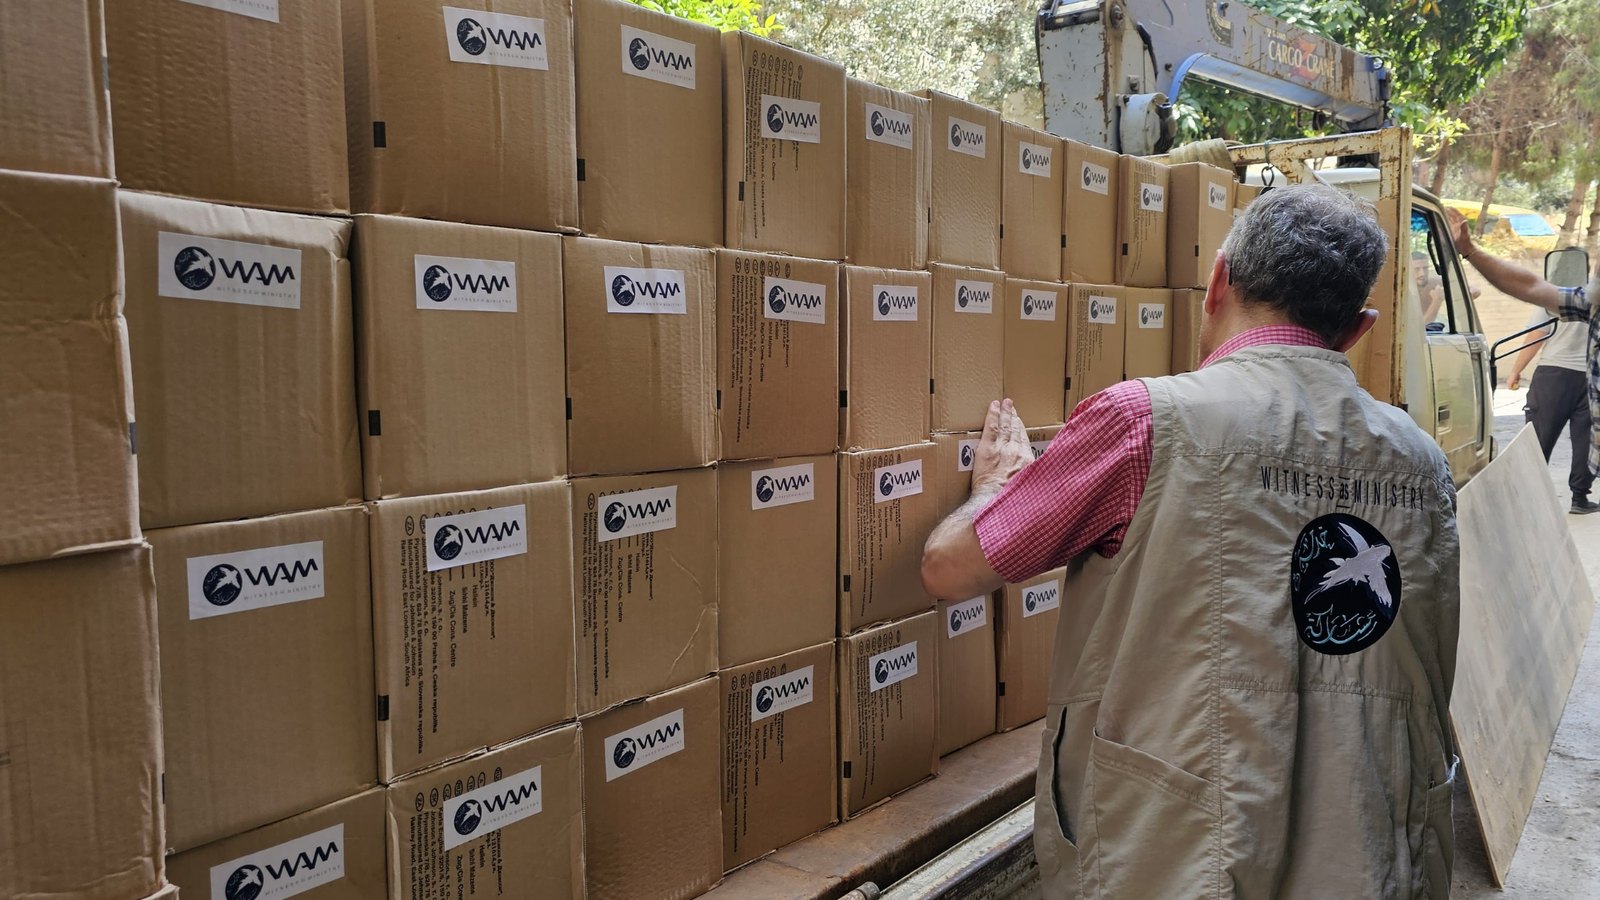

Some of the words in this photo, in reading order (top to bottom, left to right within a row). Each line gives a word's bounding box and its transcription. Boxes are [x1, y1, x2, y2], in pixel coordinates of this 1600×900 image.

[486, 27, 542, 50] WAM
[651, 48, 692, 70] WAM
[1269, 40, 1302, 68] CARGO
[1307, 54, 1334, 78] CRANE
[784, 110, 817, 128] WAM
[885, 118, 911, 135] WAM
[962, 130, 983, 146] WAM
[1032, 153, 1049, 166] WAM
[218, 258, 295, 286] WAM
[454, 273, 510, 294] WAM
[636, 282, 680, 298] WAM
[788, 292, 821, 309] WAM
[891, 296, 916, 309] WAM
[969, 290, 990, 303] WAM
[1034, 299, 1053, 311] WAM
[775, 474, 810, 492] WAM
[894, 470, 920, 486] WAM
[1261, 466, 1334, 500] WITNESS
[1340, 482, 1349, 500] as
[1354, 480, 1424, 511] MINISTRY
[628, 498, 671, 519] WAM
[464, 520, 520, 544] WAM
[244, 558, 318, 586] WAM
[1036, 588, 1056, 602] WAM
[962, 604, 983, 620] WAM
[889, 652, 915, 671] WAM
[775, 677, 809, 698] WAM
[637, 722, 680, 749] WAM
[483, 781, 537, 813] WAM
[265, 842, 338, 880] WAM
